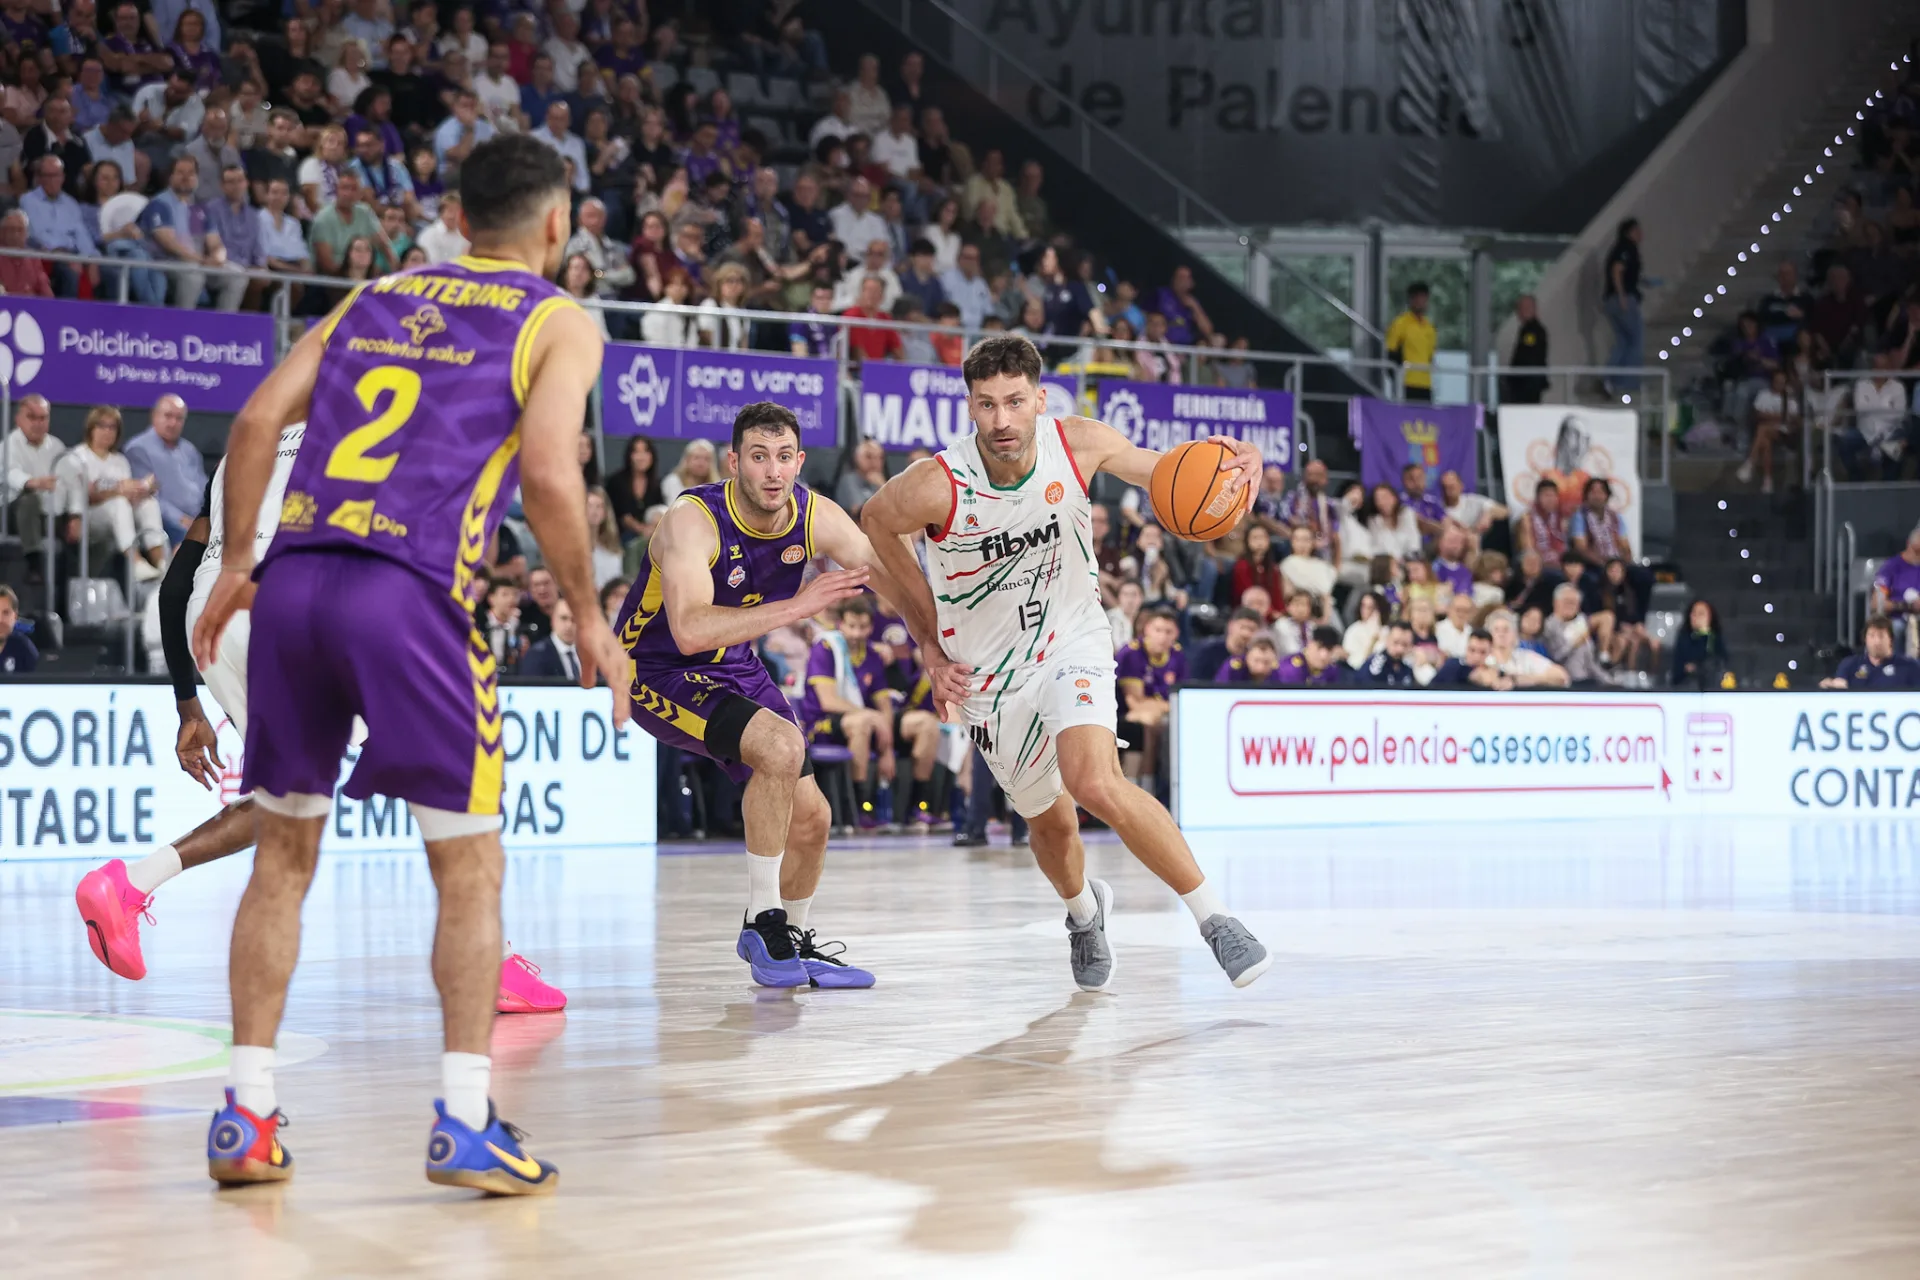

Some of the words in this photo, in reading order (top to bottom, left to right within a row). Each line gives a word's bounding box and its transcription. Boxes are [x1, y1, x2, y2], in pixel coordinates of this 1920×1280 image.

[1026, 65, 1125, 130] de
[372, 275, 527, 312] WINTERING
[59, 325, 178, 361] Policlínica
[181, 334, 264, 366] Dental
[687, 365, 744, 391] sara
[751, 370, 824, 397] varas
[324, 365, 422, 483] 2
[979, 513, 1061, 562] fibwi
[1018, 600, 1043, 631] 13
[582, 711, 629, 761] DE
[1241, 717, 1656, 783] www.palencia-asesores.com
